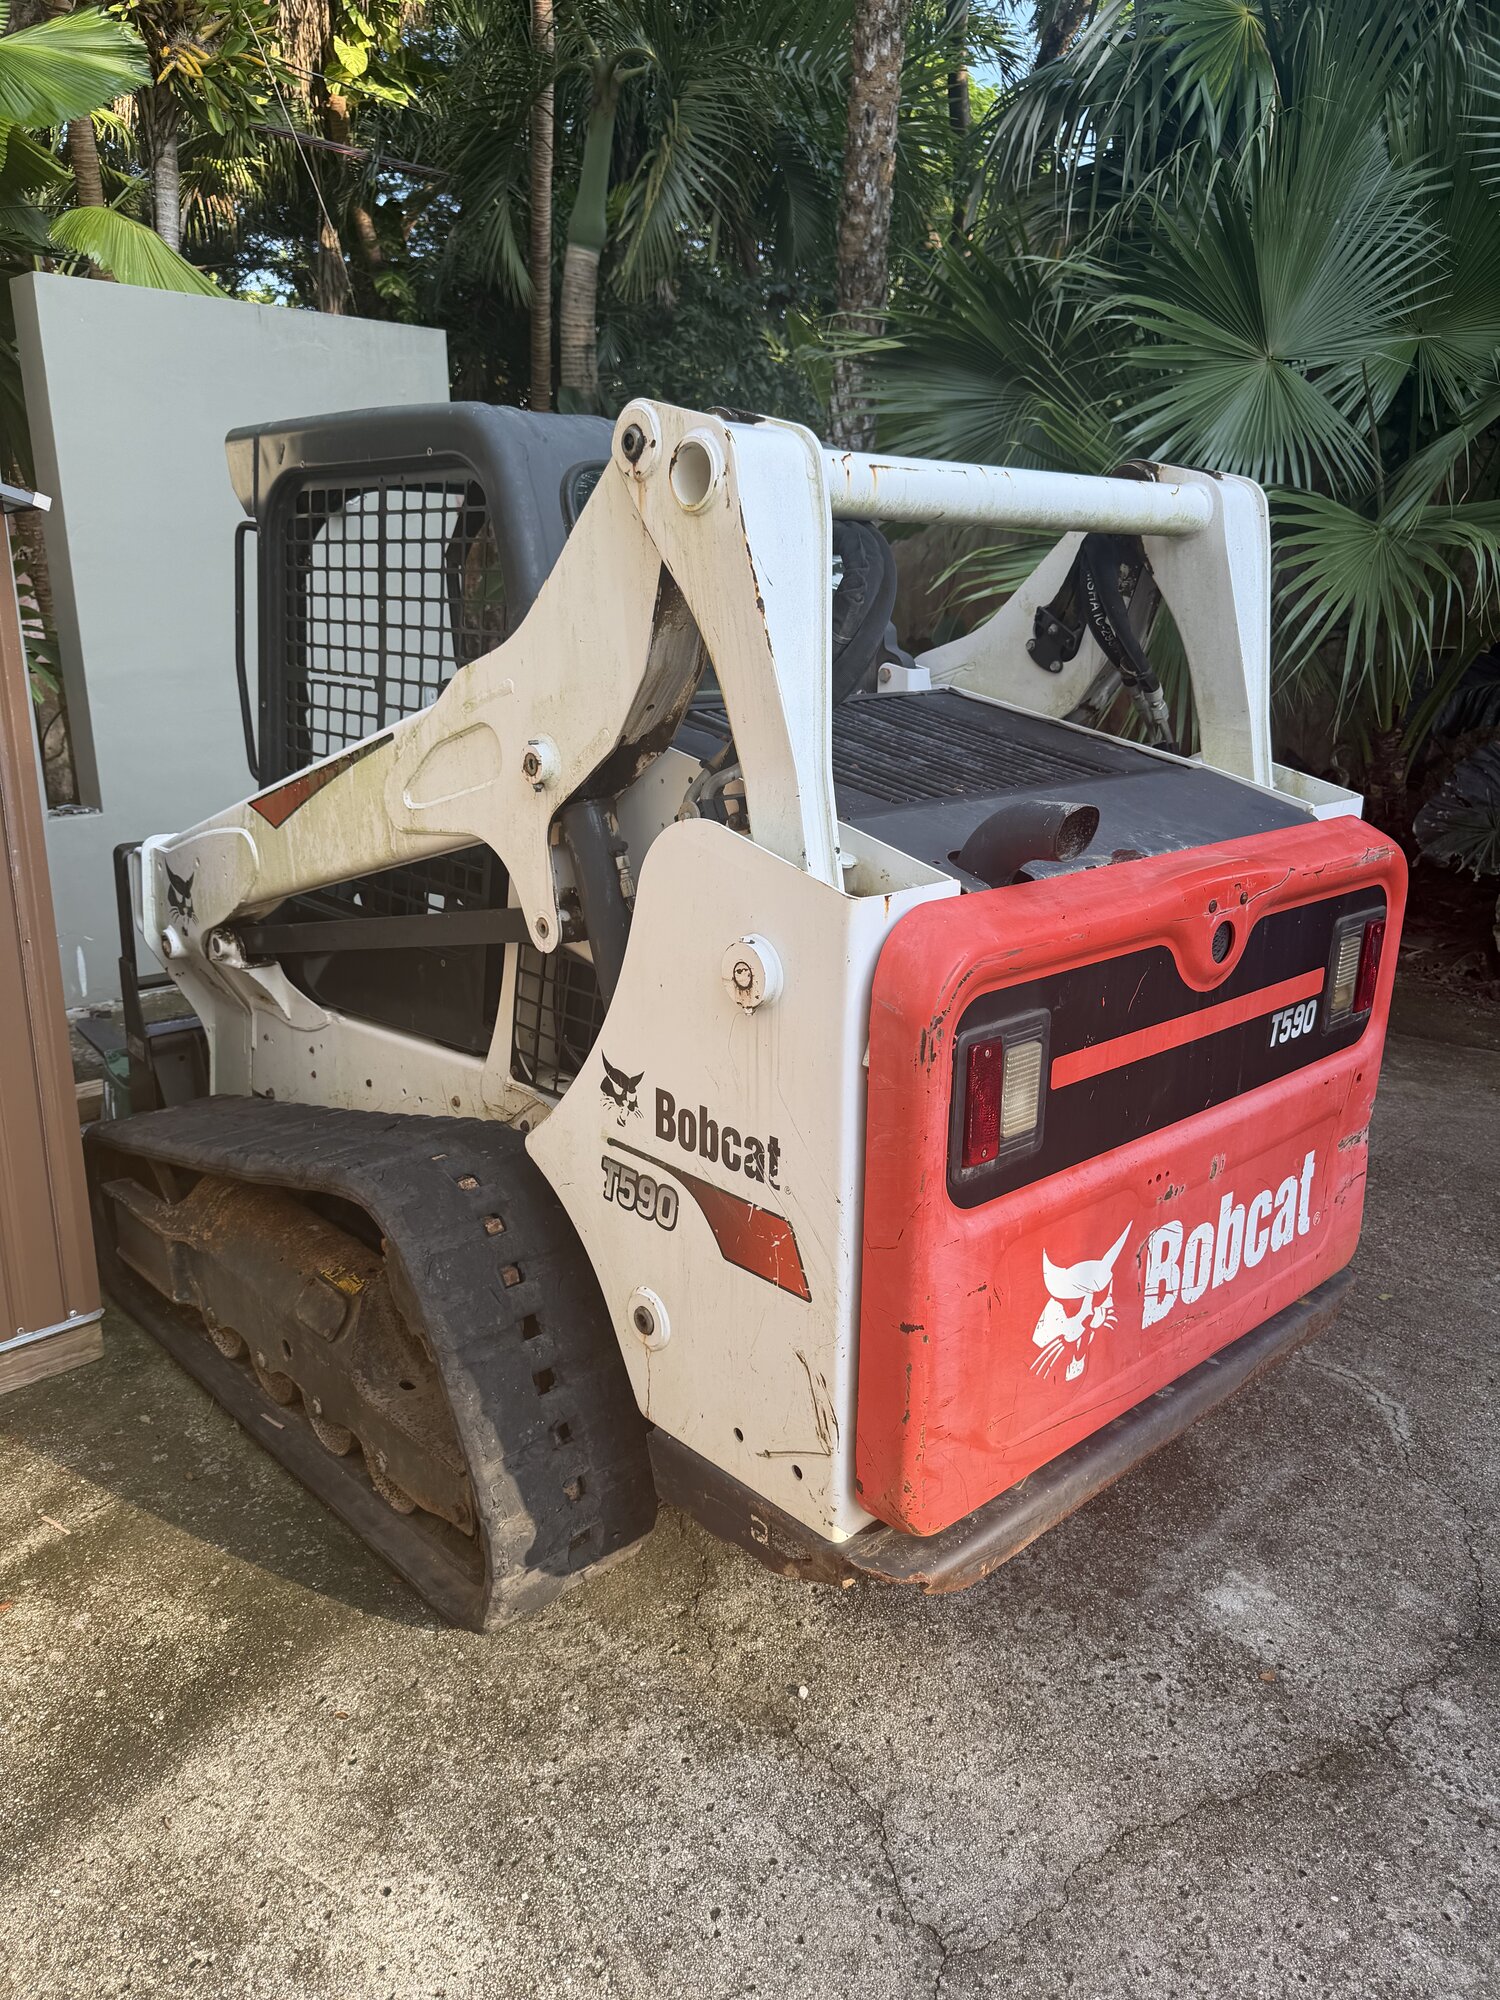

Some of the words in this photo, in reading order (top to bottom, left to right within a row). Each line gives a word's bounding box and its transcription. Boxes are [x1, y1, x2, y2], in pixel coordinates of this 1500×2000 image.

[1269, 999, 1318, 1048] T590
[655, 1086, 781, 1191] Bobcat
[600, 1154, 680, 1232] T590
[1141, 1149, 1316, 1330] Bobcat
